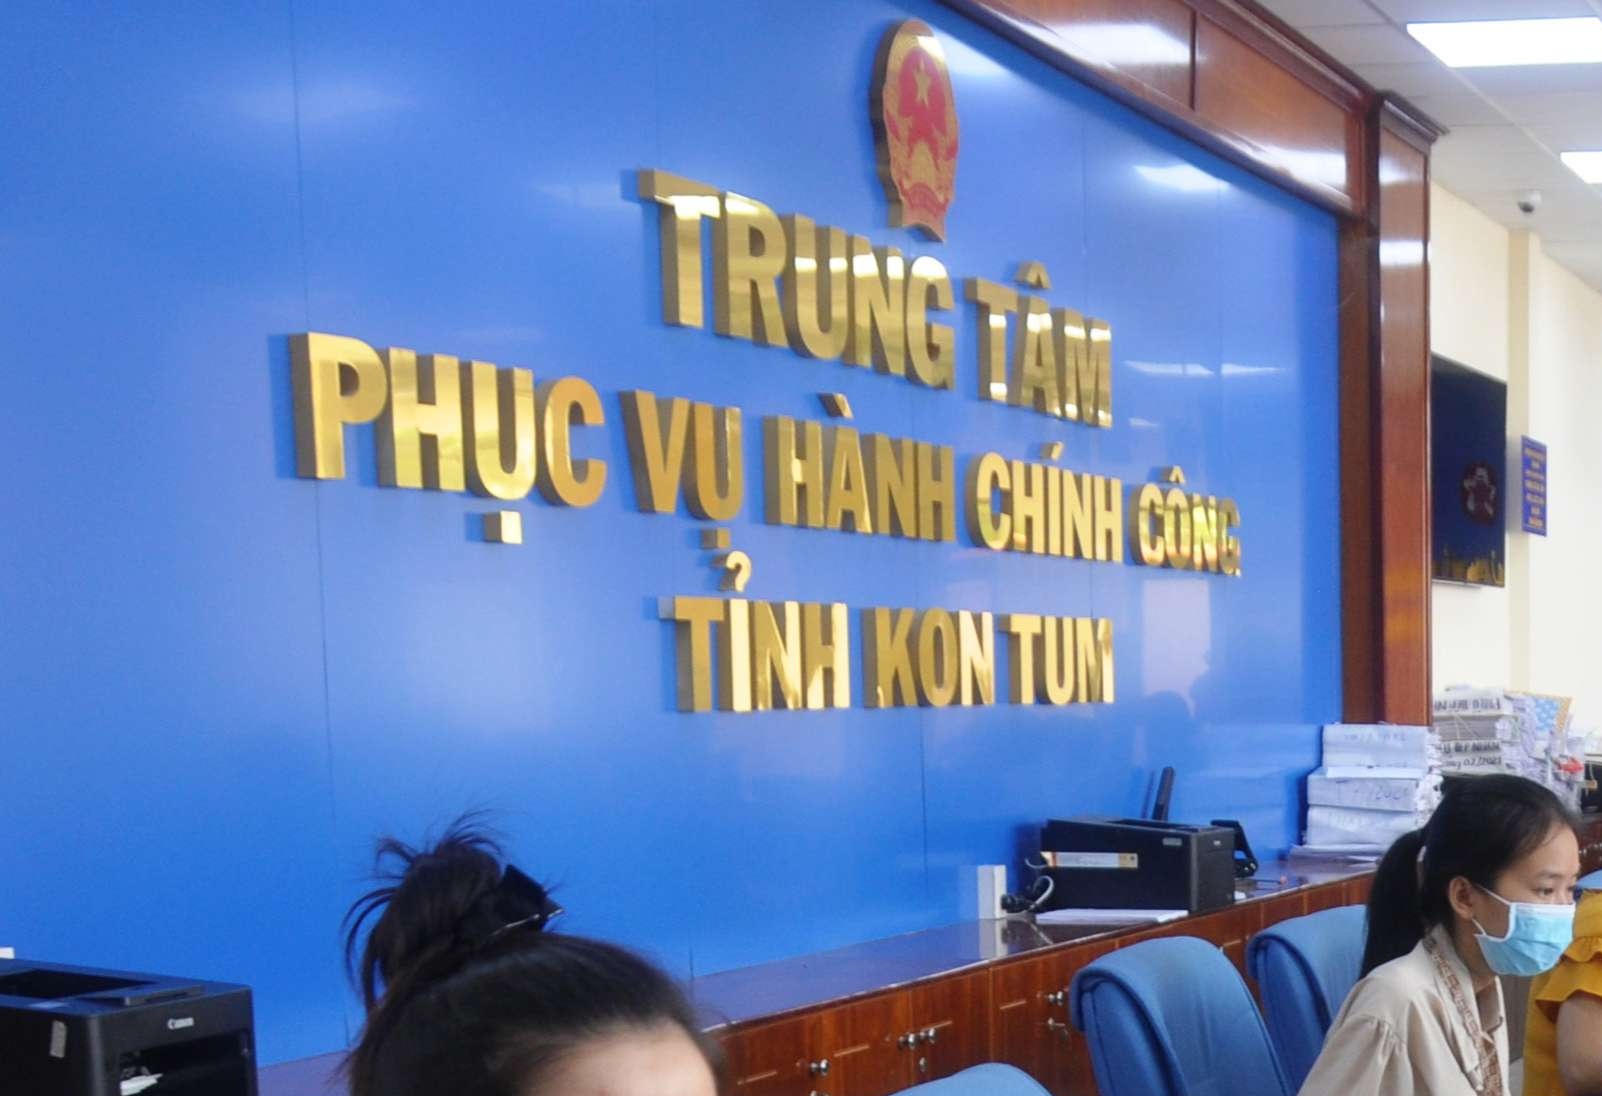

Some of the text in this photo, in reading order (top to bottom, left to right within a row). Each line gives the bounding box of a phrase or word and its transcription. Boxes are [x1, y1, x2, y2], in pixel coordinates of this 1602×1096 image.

[638, 168, 1112, 428] TRUNG TÂM
[291, 331, 1242, 576] PHỤC VỤ HÀNH CHÍNH CÔNG
[660, 550, 1115, 712] TỈNH KON TUM
